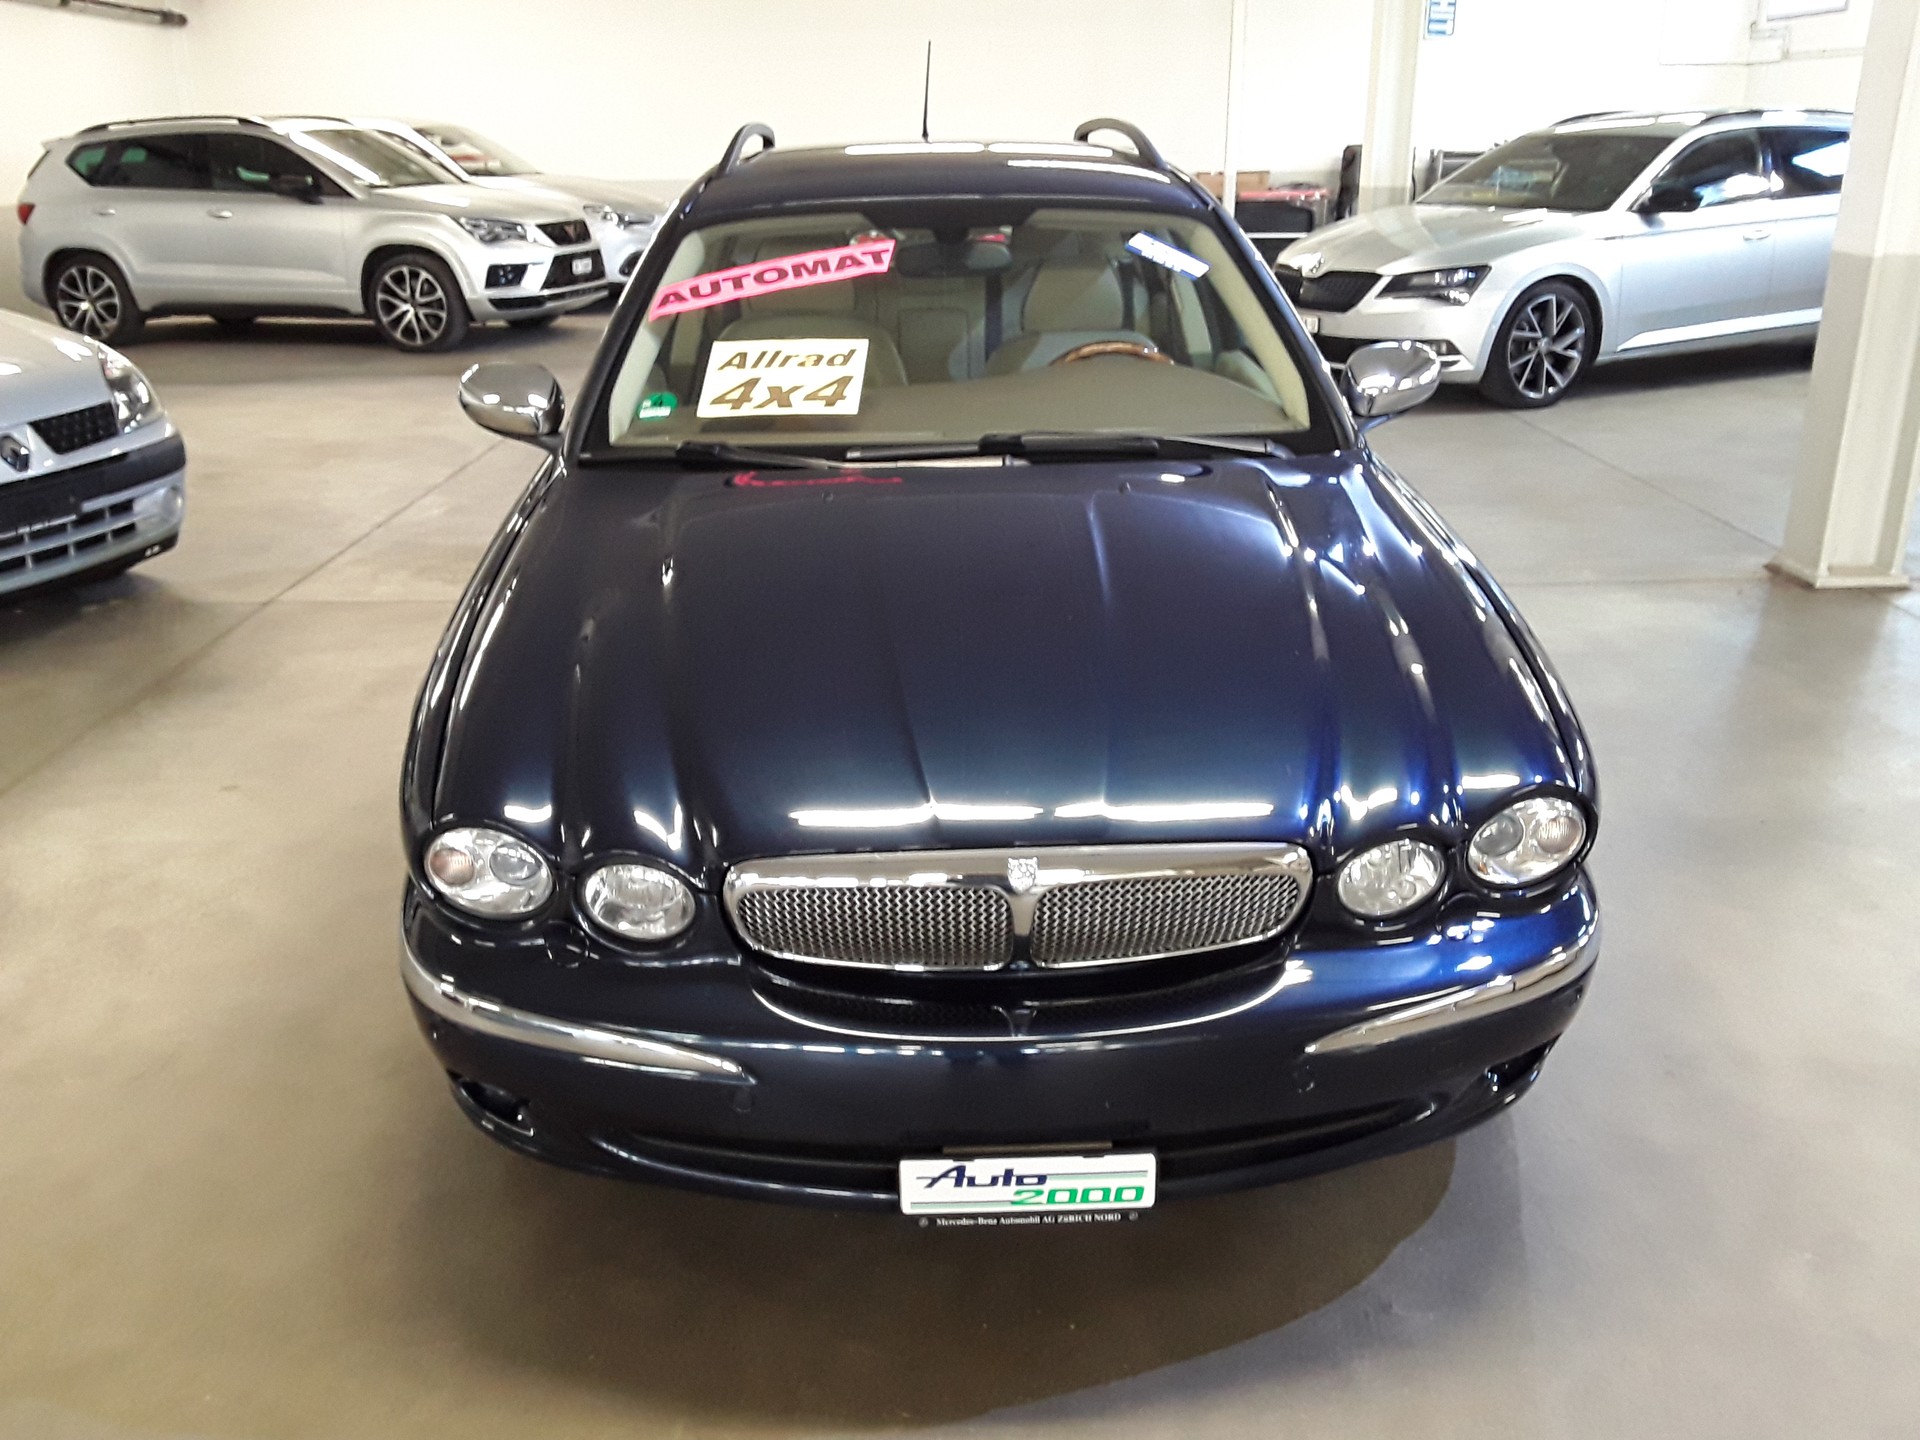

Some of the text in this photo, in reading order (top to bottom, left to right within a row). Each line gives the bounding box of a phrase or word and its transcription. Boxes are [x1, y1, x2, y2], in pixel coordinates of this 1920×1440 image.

[656, 249, 890, 309] AUTOMAT
[717, 349, 857, 371] Allrad
[709, 376, 854, 410] 4x4
[924, 1165, 1047, 1189] Auto
[1011, 1186, 1145, 1205] 2000
[1000, 1215, 1040, 1226] Automobil
[1093, 1212, 1121, 1222] NORD
